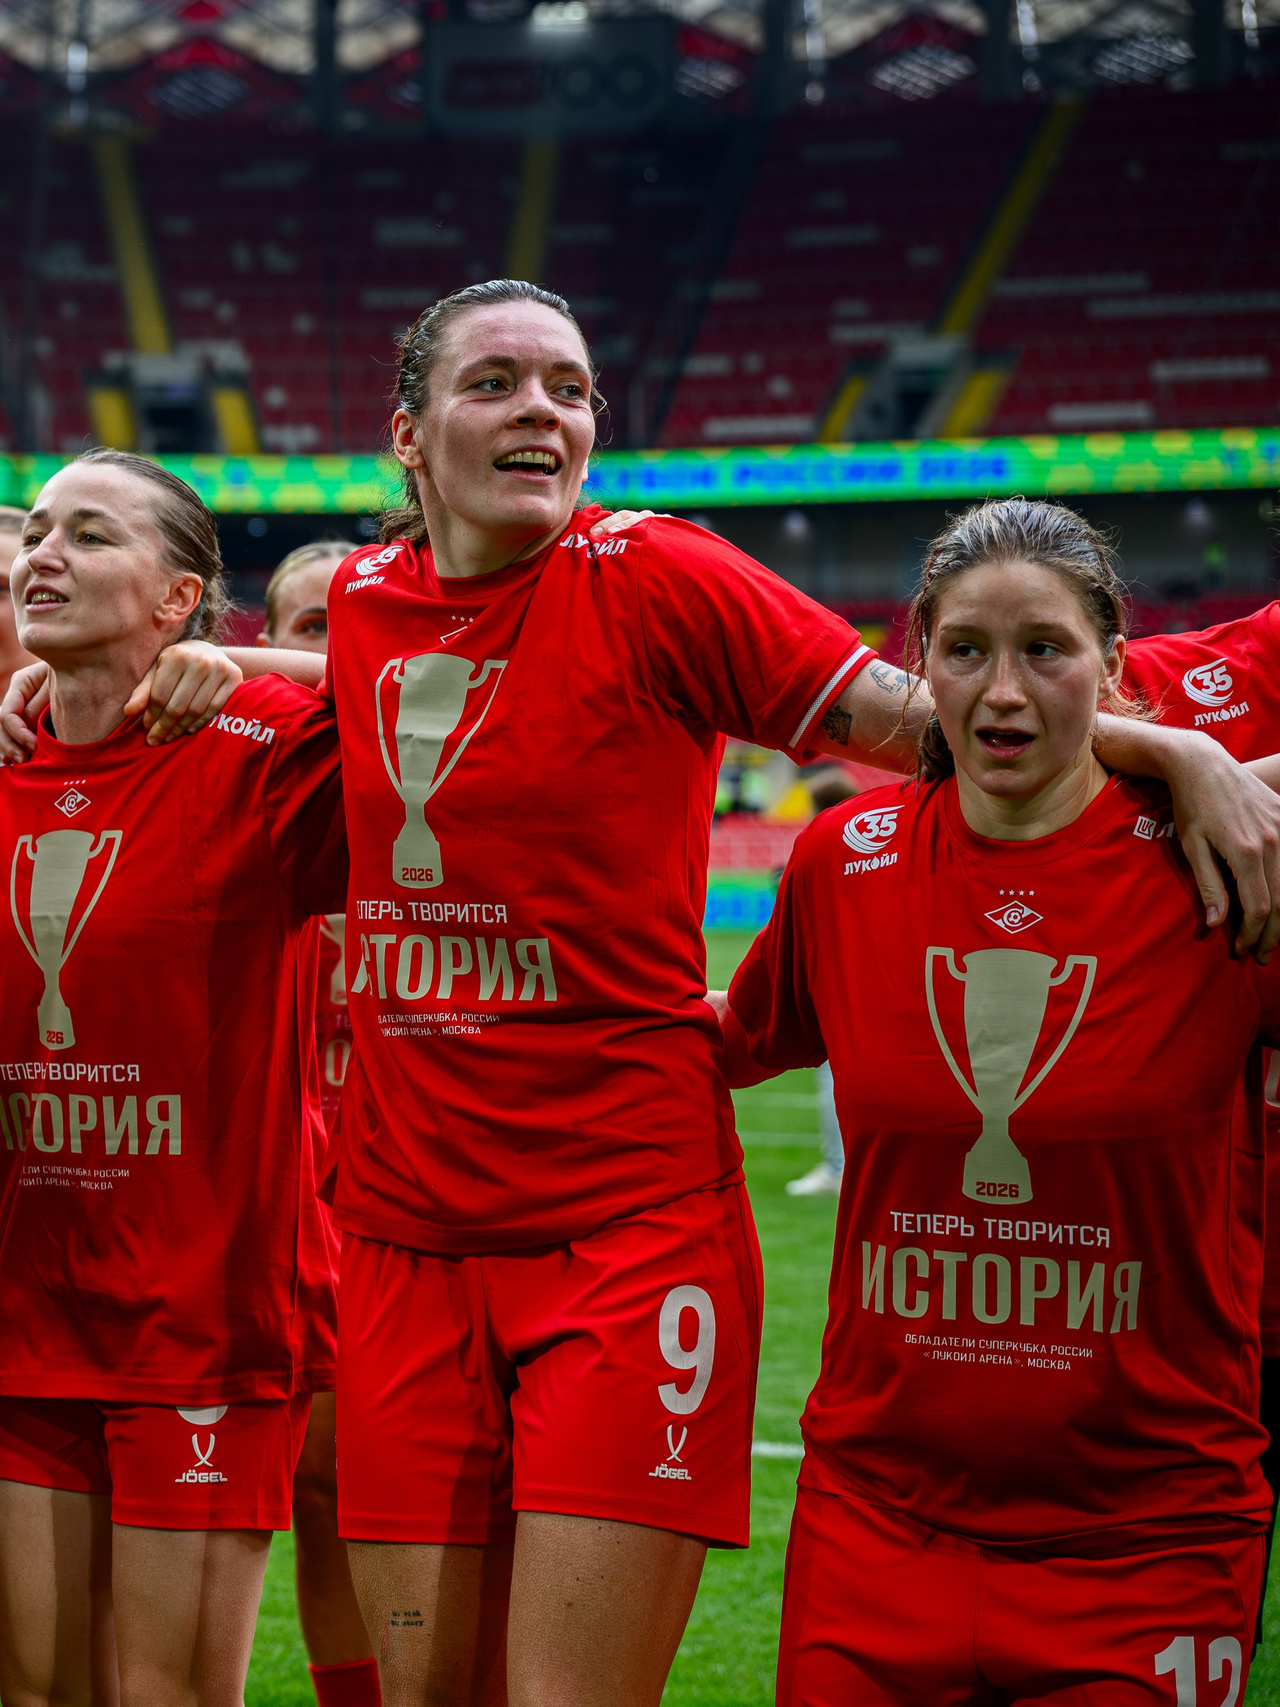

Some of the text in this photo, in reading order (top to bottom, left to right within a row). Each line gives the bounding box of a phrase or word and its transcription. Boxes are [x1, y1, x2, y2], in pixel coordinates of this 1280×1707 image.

[1196, 665, 1233, 695] 35
[1194, 701, 1250, 727] ЛУКОЙЛ
[861, 812, 898, 839] 35
[401, 867, 434, 882] 2026
[843, 852, 898, 876] ЛУКОЙЛ
[356, 900, 508, 924] ПЕРЬ ТВОРИТСЯ
[350, 932, 558, 1002] ТОРИЯ
[461, 1013, 500, 1023] РОССИИ
[442, 1025, 482, 1036] МОСКВА
[46, 1062, 140, 1083] ВОРИТСЯ
[42, 1165, 92, 1177] СУПЕРКУБКА
[93, 1168, 130, 1178] РОССИИ
[80, 1180, 114, 1190] МОСКВА
[976, 1181, 1020, 1198] 2026
[890, 1211, 1111, 1248] ТЕПЕРЬ ТВОРИТСЯ
[861, 1240, 1142, 1334] ИСТОРИЯ
[657, 1284, 716, 1416] 9
[905, 1333, 1093, 1358] ОБЛАДАТЕЛИ СУПЕРКУБКА РОССИИ
[1027, 1357, 1071, 1371] МОСКВА
[175, 1469, 228, 1483] JÖGEL
[648, 1463, 692, 1480] JÖGEL
[1154, 1636, 1242, 1707] 12
